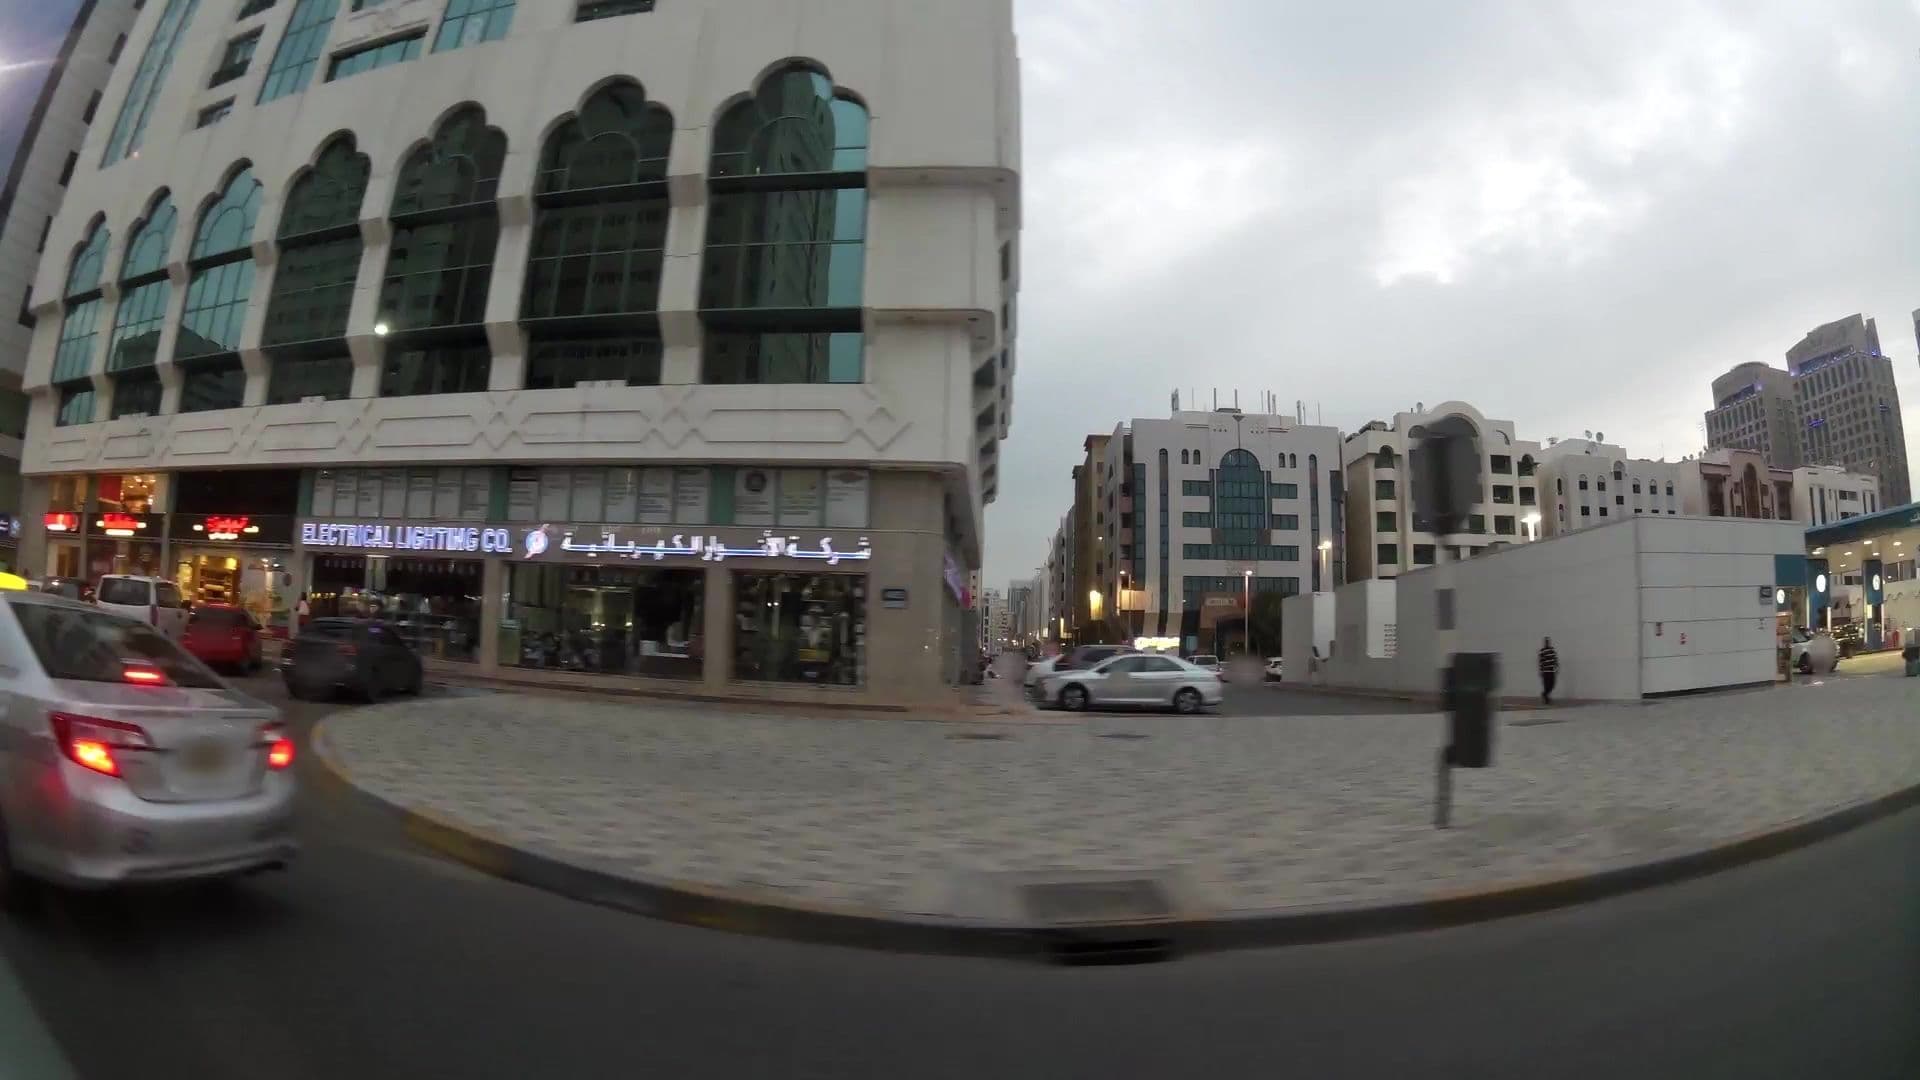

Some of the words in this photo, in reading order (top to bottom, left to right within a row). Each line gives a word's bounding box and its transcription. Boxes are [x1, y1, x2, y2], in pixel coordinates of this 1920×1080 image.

[301, 523, 393, 548] ELECTRICAL
[395, 526, 480, 551] LIGHTING
[481, 528, 512, 553] CO.
[784, 535, 872, 565] شركة
